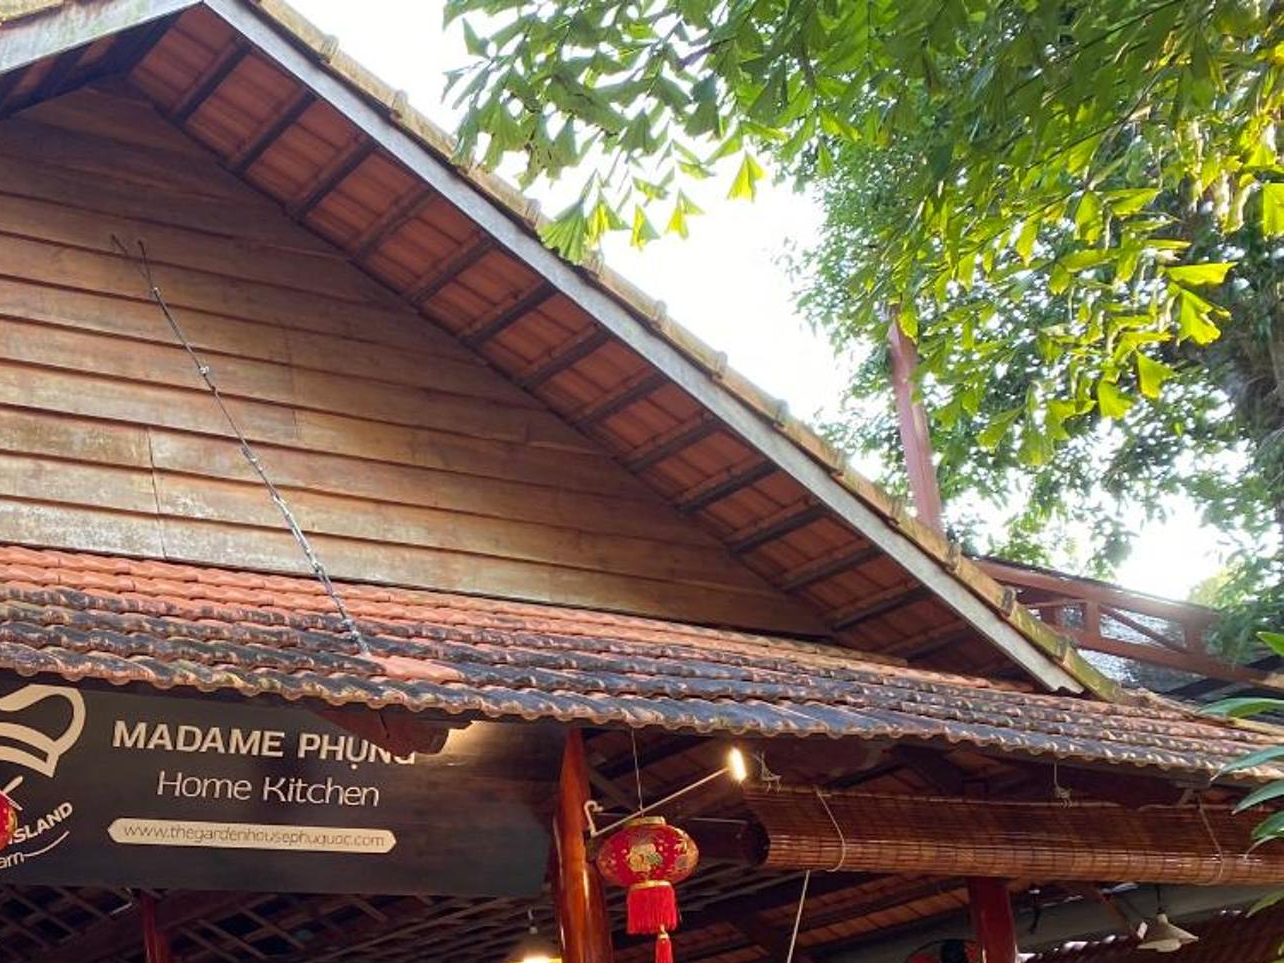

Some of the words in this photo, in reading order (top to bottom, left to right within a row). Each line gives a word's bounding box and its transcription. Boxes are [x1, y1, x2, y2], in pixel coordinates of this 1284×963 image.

[112, 719, 285, 757] MADAME
[156, 771, 252, 801] Home
[262, 776, 380, 807] Kitchen
[123, 824, 385, 848] www.thegardenhousephuquoc.com
